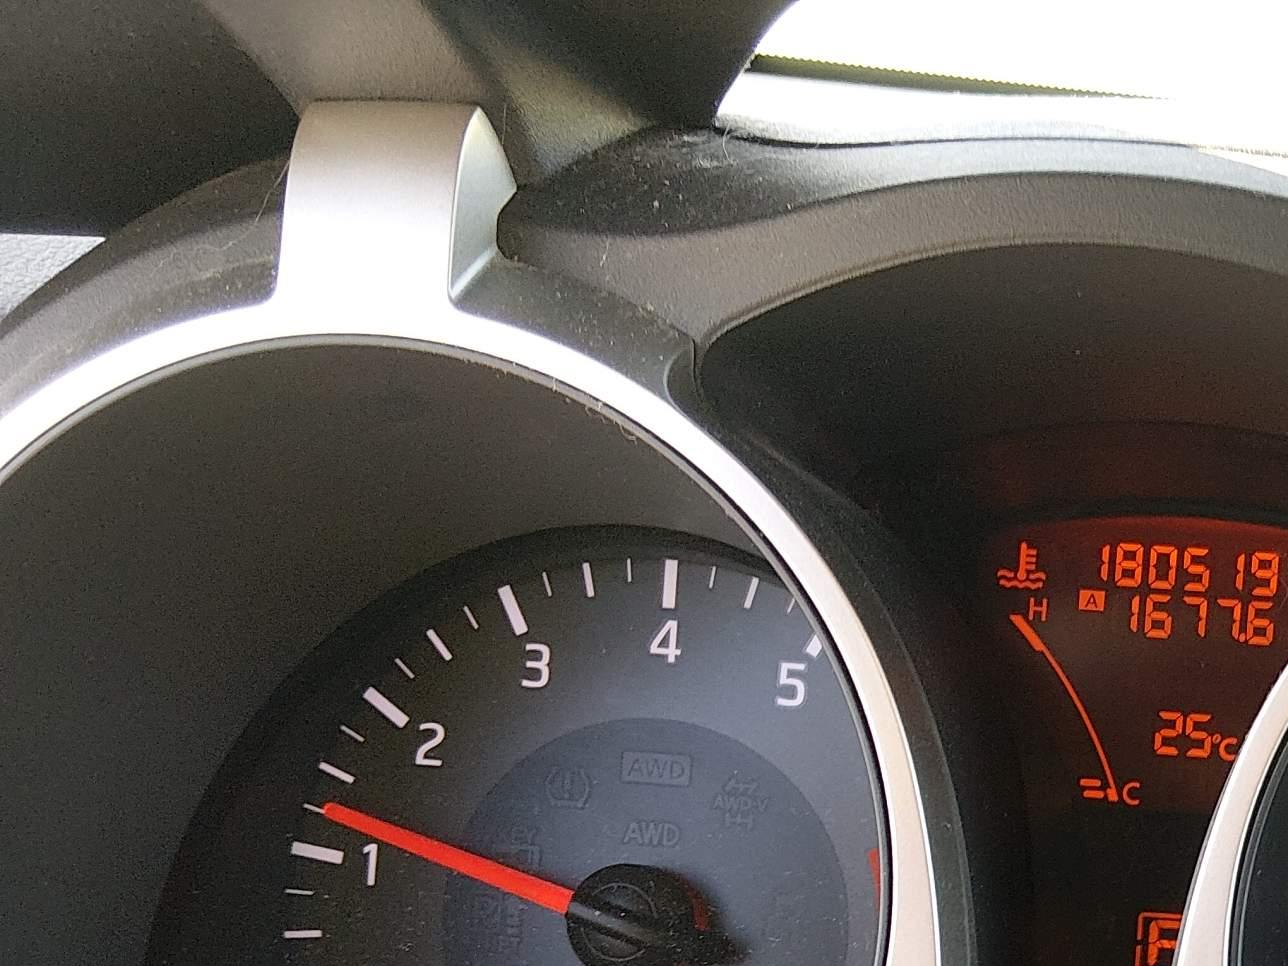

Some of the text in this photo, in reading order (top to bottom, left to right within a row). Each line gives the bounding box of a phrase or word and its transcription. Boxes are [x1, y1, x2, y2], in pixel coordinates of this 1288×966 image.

[1100, 541, 1280, 597] 180519
[1028, 597, 1048, 622] H
[1129, 592, 1275, 646] 1677.6
[649, 619, 682, 664] 4
[521, 643, 551, 688] 3
[776, 662, 807, 707] 5
[415, 722, 445, 767] 2
[626, 757, 686, 780] AWD
[1122, 781, 1141, 806] C
[623, 820, 681, 847] AWD
[362, 843, 378, 886] 1
